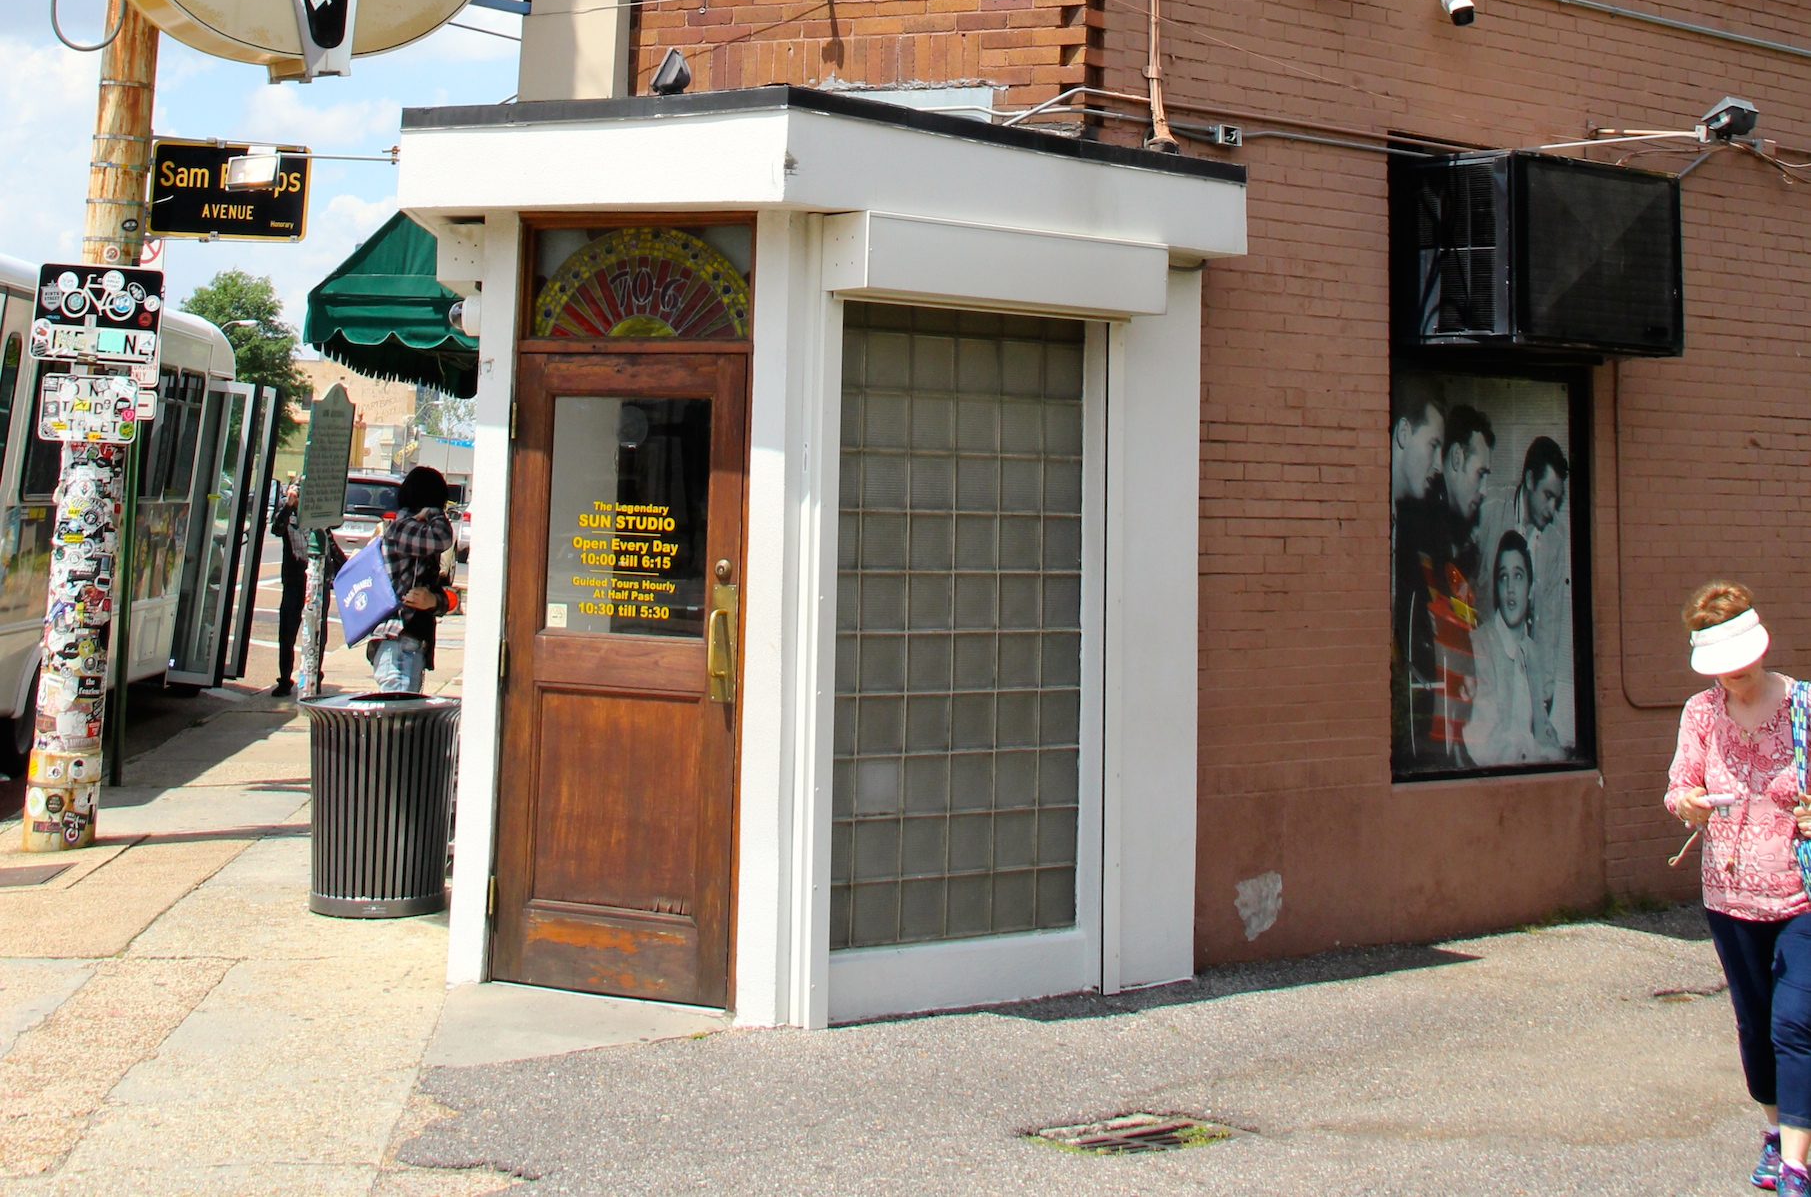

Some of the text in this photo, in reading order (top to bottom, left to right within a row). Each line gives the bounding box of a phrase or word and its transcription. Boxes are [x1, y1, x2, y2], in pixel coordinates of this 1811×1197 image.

[160, 160, 209, 188] Sam
[202, 204, 254, 220] AVENUE
[270, 220, 294, 230] Honorary
[610, 268, 682, 311] 706
[593, 501, 669, 516] The Legendary
[578, 513, 675, 531] SUN STUDIO
[572, 536, 679, 556] Open Every Day
[580, 552, 671, 569] 10:00 till 6:15
[572, 576, 675, 593] Guided Tours Hourly
[593, 589, 654, 601] At Half Past
[578, 602, 669, 619] 10:30 till 5:30
